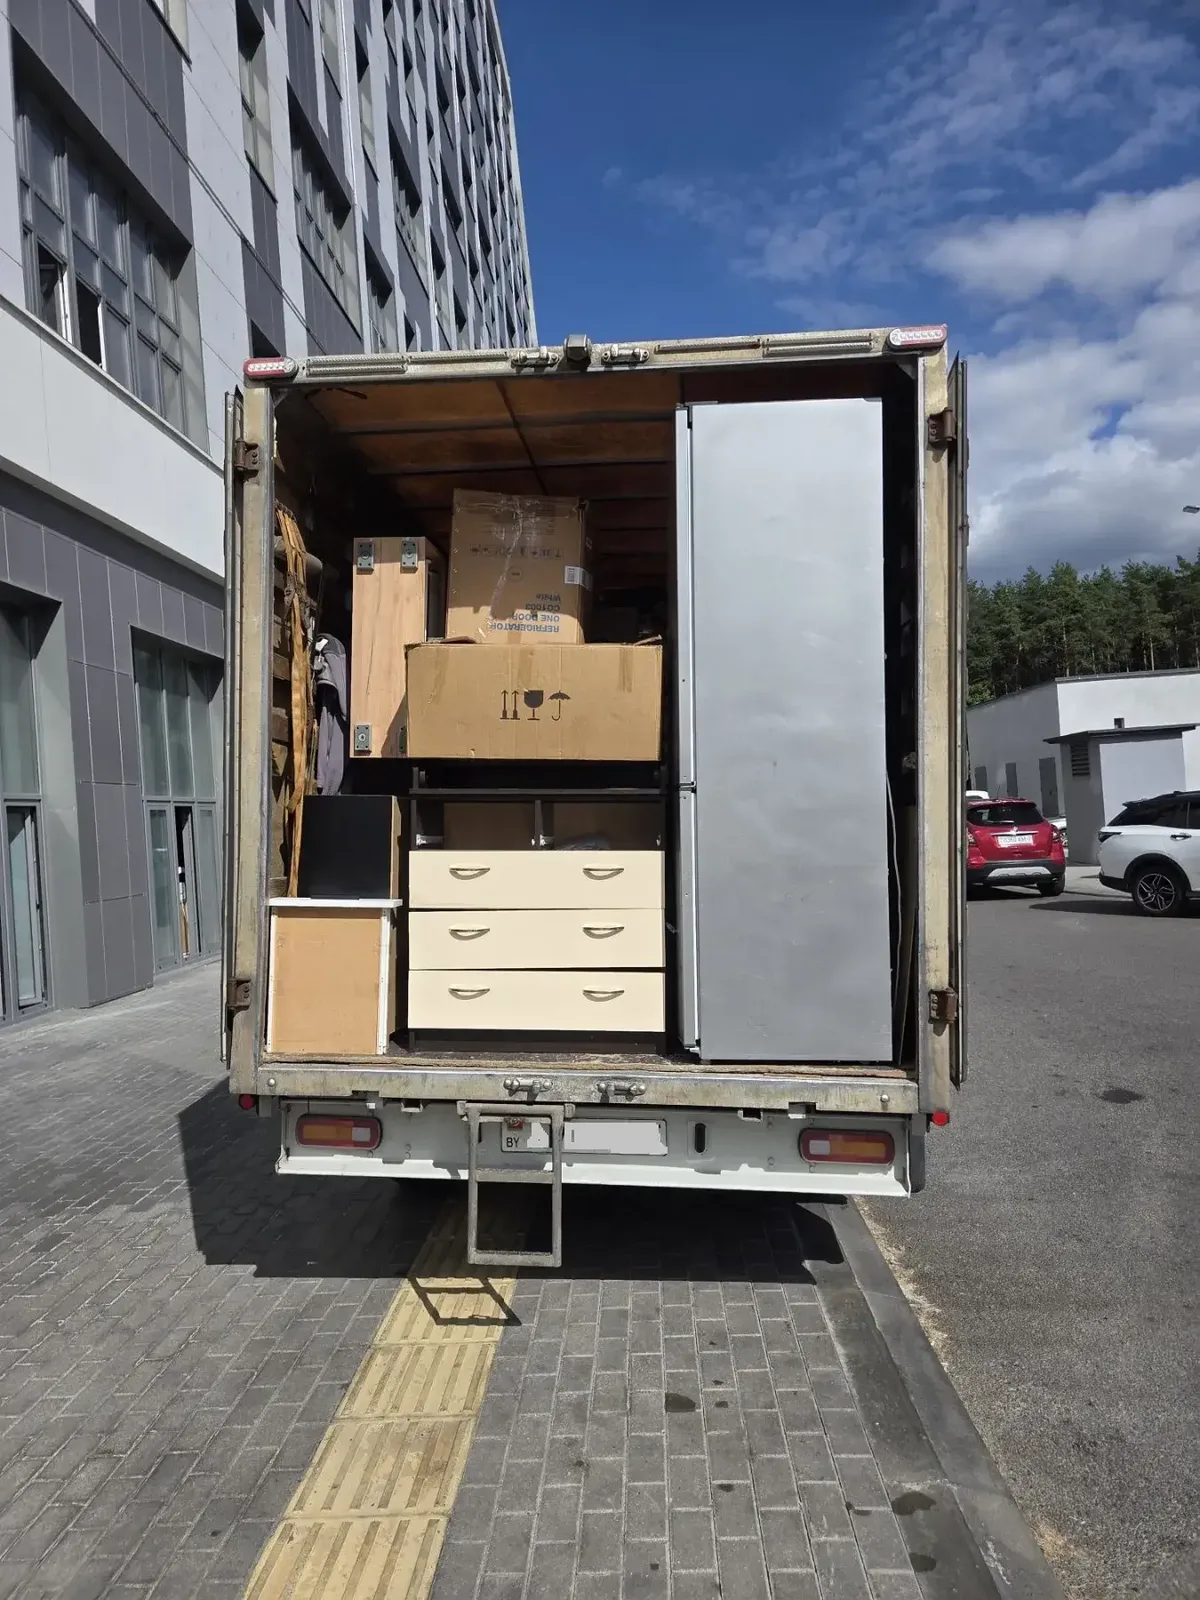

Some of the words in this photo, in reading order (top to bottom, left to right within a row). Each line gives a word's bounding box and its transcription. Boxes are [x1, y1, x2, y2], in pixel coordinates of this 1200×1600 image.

[535, 593, 561, 602] White
[511, 612, 538, 621] DOOR
[540, 614, 560, 622] ONE
[490, 622, 560, 633] REFRIGERATOR
[506, 1136, 520, 1148] BY
